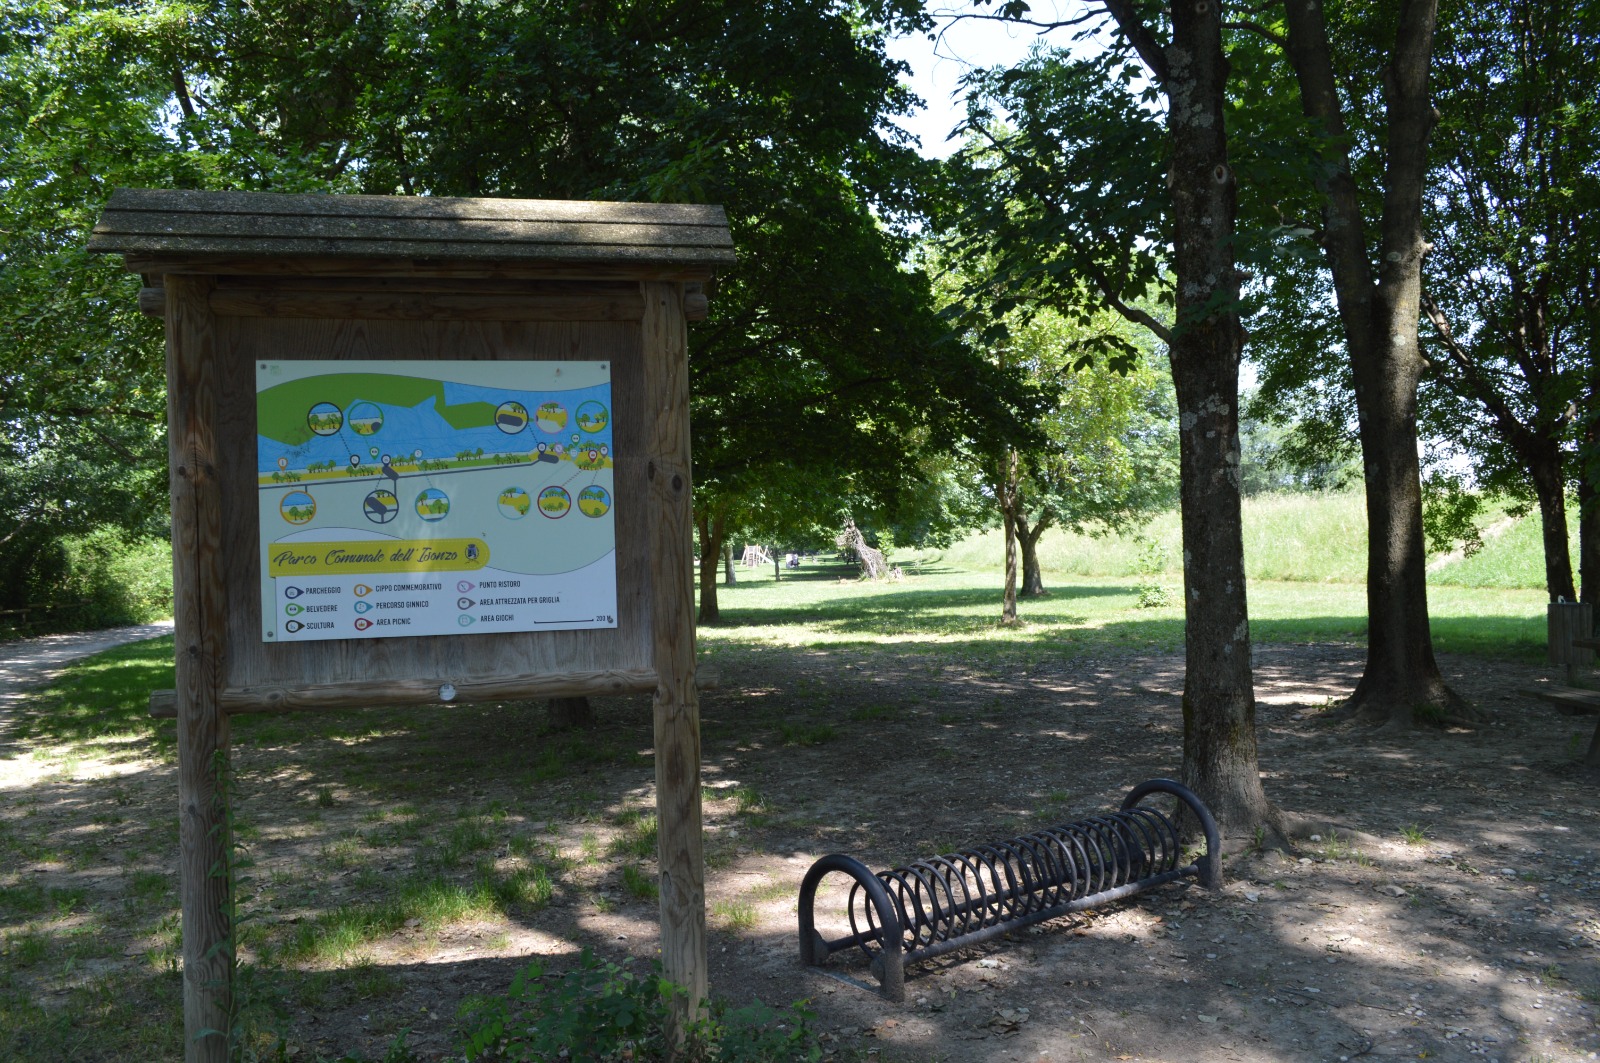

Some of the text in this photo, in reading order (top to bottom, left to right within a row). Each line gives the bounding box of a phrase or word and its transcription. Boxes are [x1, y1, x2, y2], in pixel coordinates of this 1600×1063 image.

[273, 550, 317, 567] Parco
[325, 548, 385, 565] Comunale
[305, 586, 342, 594] PARCHEGGIO
[375, 583, 442, 592] CIPPO COMMEMORATIVO
[376, 600, 429, 610] PERCORSO GINNICO
[494, 598, 526, 606] ATTREZZATA
[306, 604, 338, 612] BELVEDERE
[306, 622, 335, 630] SCULTURA
